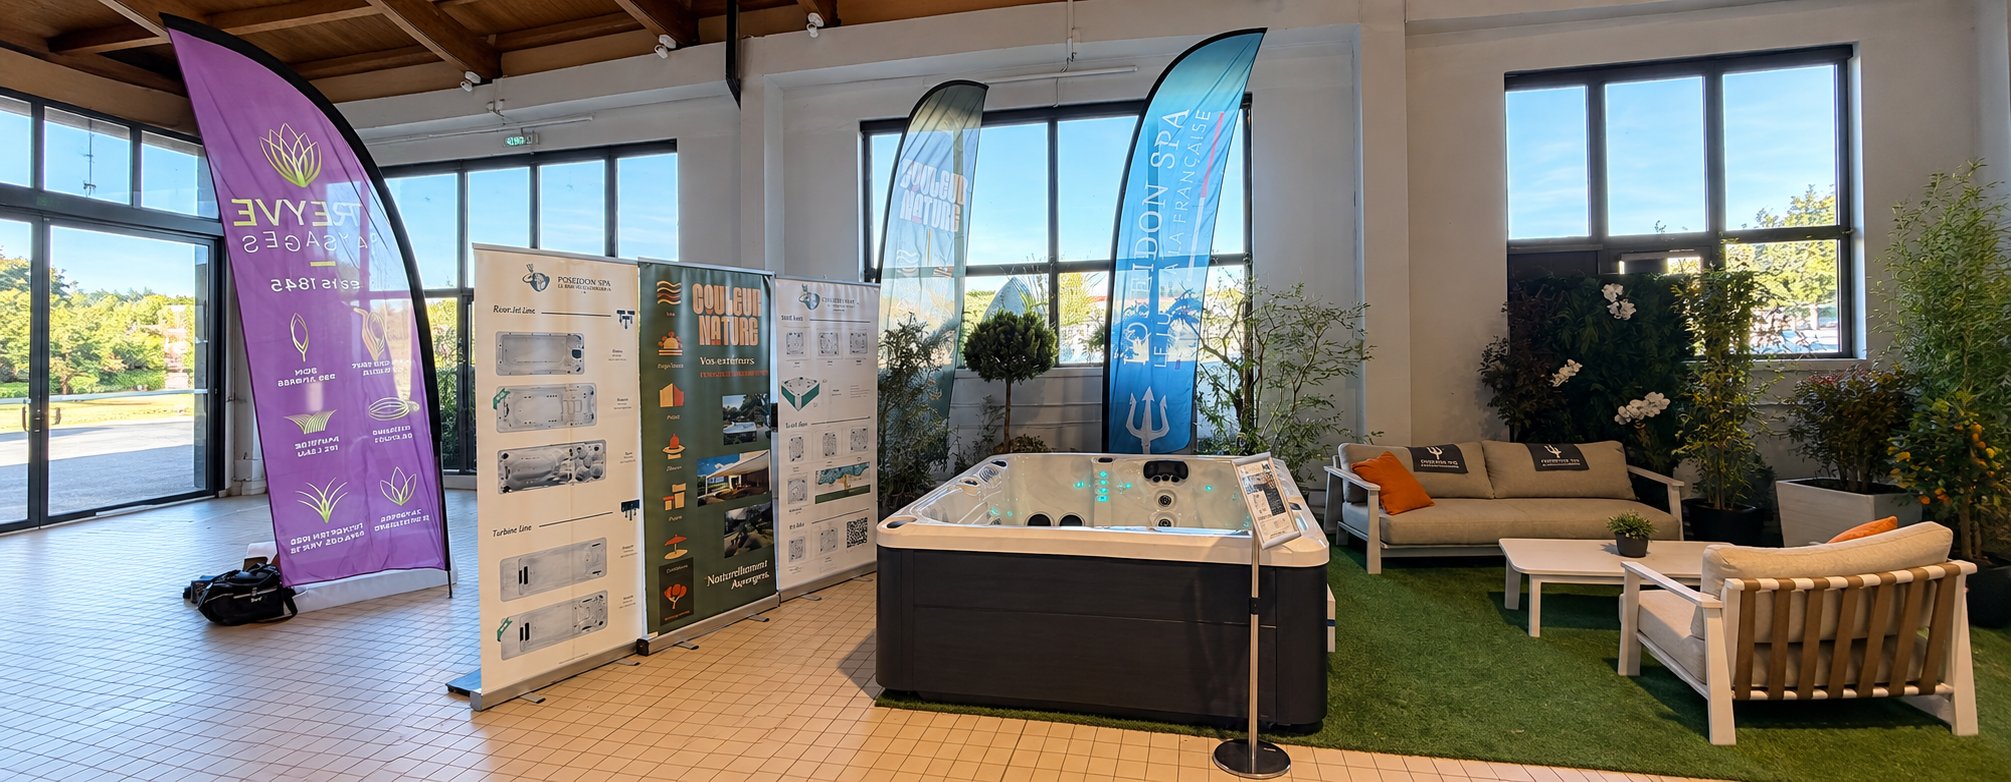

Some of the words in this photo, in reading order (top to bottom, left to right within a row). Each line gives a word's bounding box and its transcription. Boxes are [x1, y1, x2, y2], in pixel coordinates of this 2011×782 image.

[1173, 110, 1211, 224] FRANÇAISE
[900, 189, 961, 232] NATURE
[1123, 184, 1169, 366] OEIDON
[1151, 109, 1190, 168] SPA
[692, 283, 762, 317] COULEUR
[698, 314, 759, 346] NATURE
[492, 527, 517, 538] Turbine
[518, 524, 533, 533] Line
